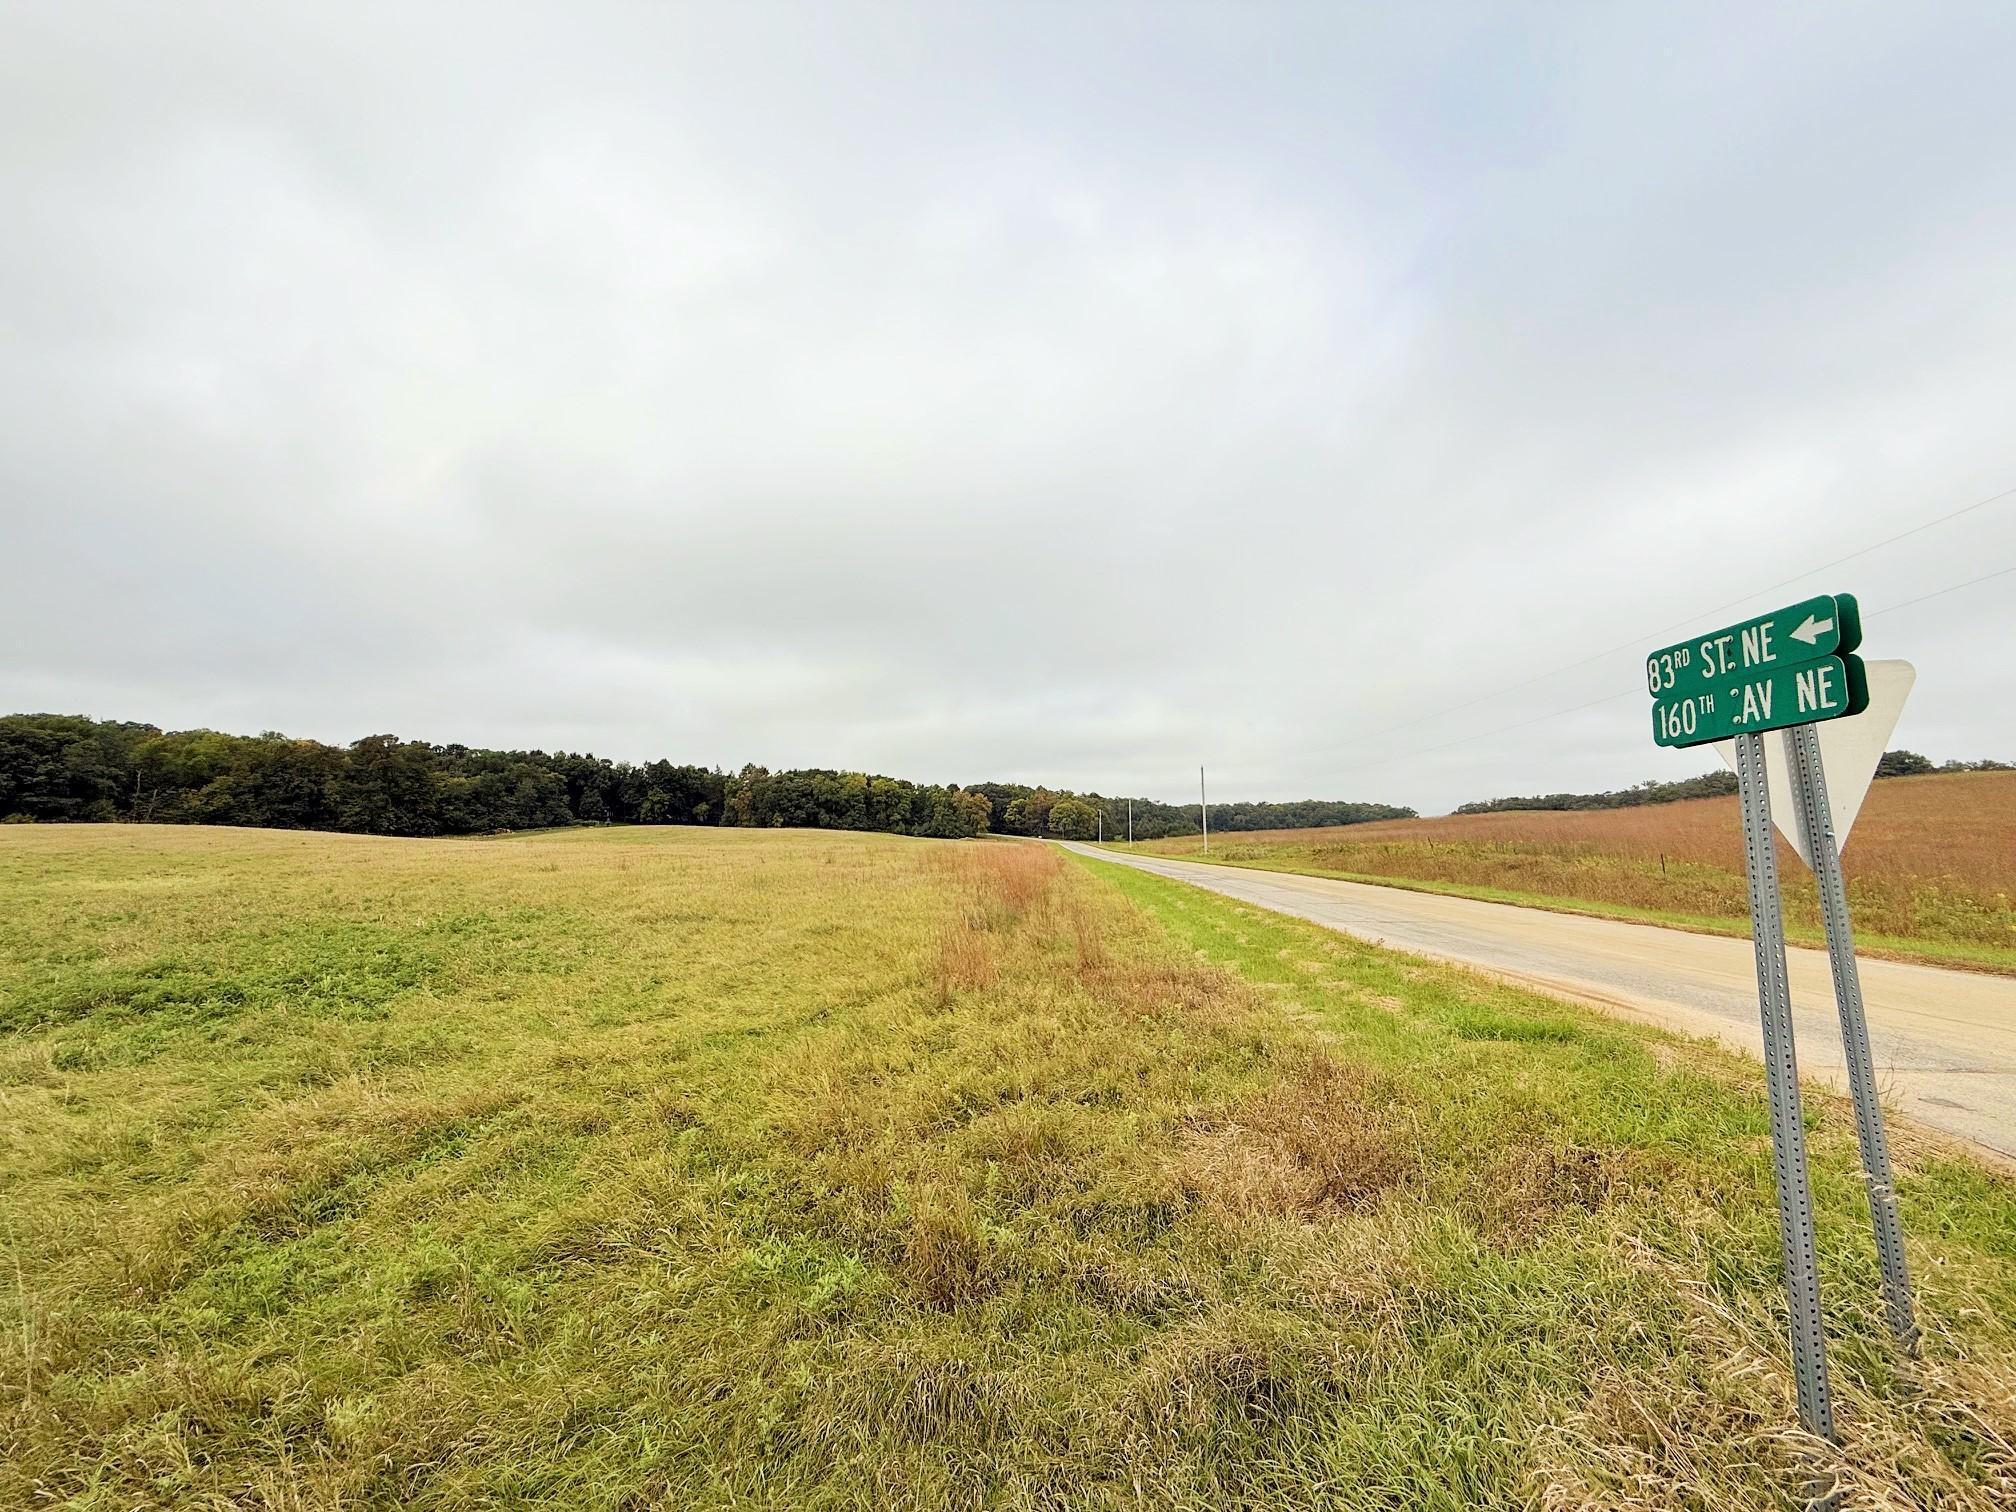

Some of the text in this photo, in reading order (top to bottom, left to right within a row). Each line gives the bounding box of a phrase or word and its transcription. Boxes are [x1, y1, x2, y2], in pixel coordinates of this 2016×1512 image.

[1648, 648, 1690, 693] 83RD
[1742, 621, 1776, 668] NE
[1658, 665, 1837, 739] 160TH AV NE
